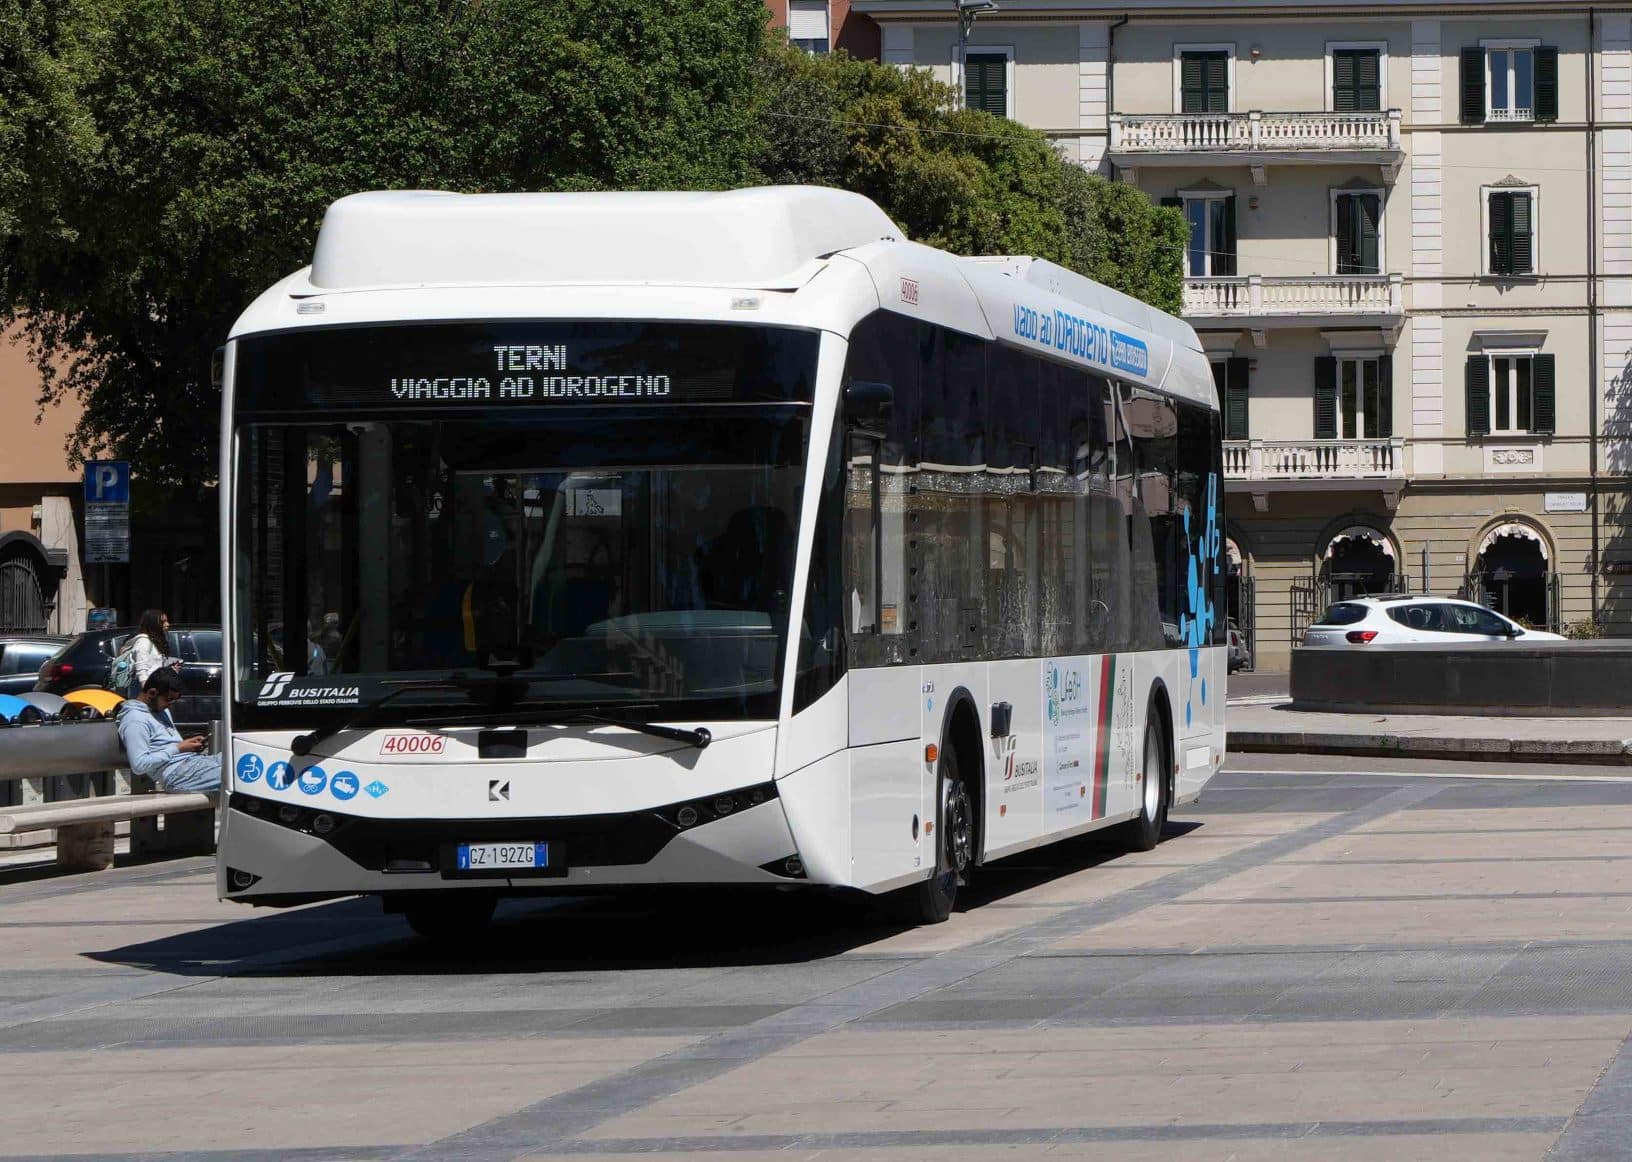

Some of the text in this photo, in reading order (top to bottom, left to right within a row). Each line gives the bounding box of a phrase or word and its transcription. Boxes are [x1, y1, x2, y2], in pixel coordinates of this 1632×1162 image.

[494, 345, 567, 371] TERNI
[391, 375, 670, 399] VIAGGIA AD IDROGENO
[95, 465, 119, 499] P
[288, 687, 360, 699] BUSITALIA
[385, 736, 443, 753] 40006
